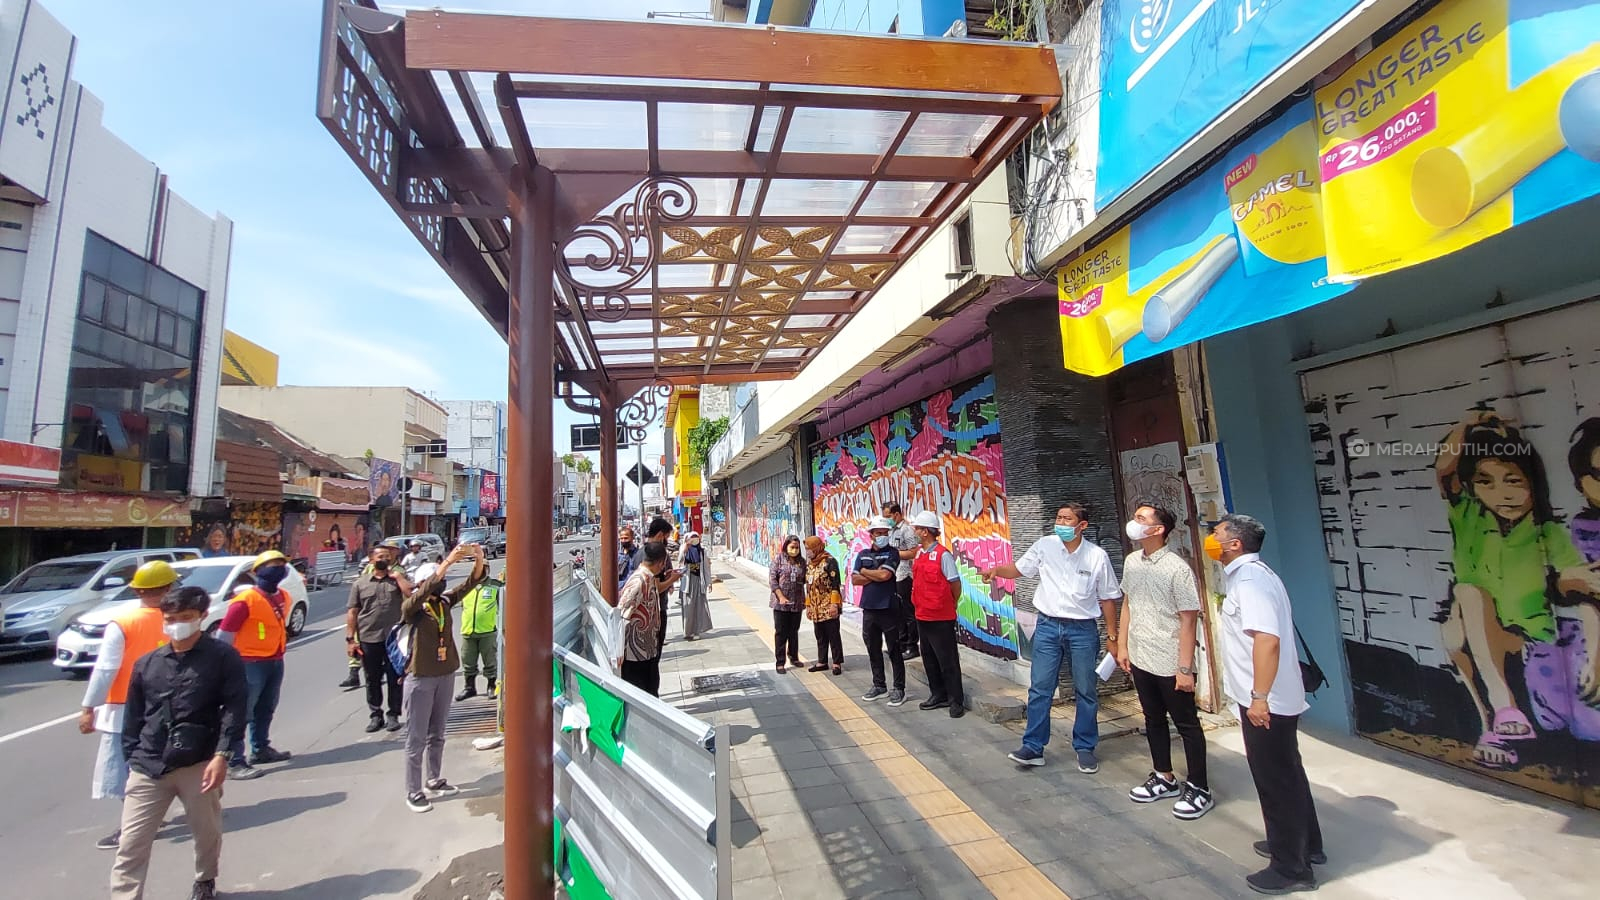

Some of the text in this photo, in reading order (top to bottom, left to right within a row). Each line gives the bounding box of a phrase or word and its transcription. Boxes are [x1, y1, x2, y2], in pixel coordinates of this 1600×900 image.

[1318, 24, 1444, 119] LONGER
[1322, 80, 1397, 136] GREAT
[1402, 22, 1486, 86] TASTE
[1393, 124, 1423, 146] BATANG
[1226, 159, 1253, 186] NEW
[1233, 170, 1314, 222] CAMEL
[1063, 249, 1109, 284] LONGER
[1093, 256, 1121, 279] TASTE
